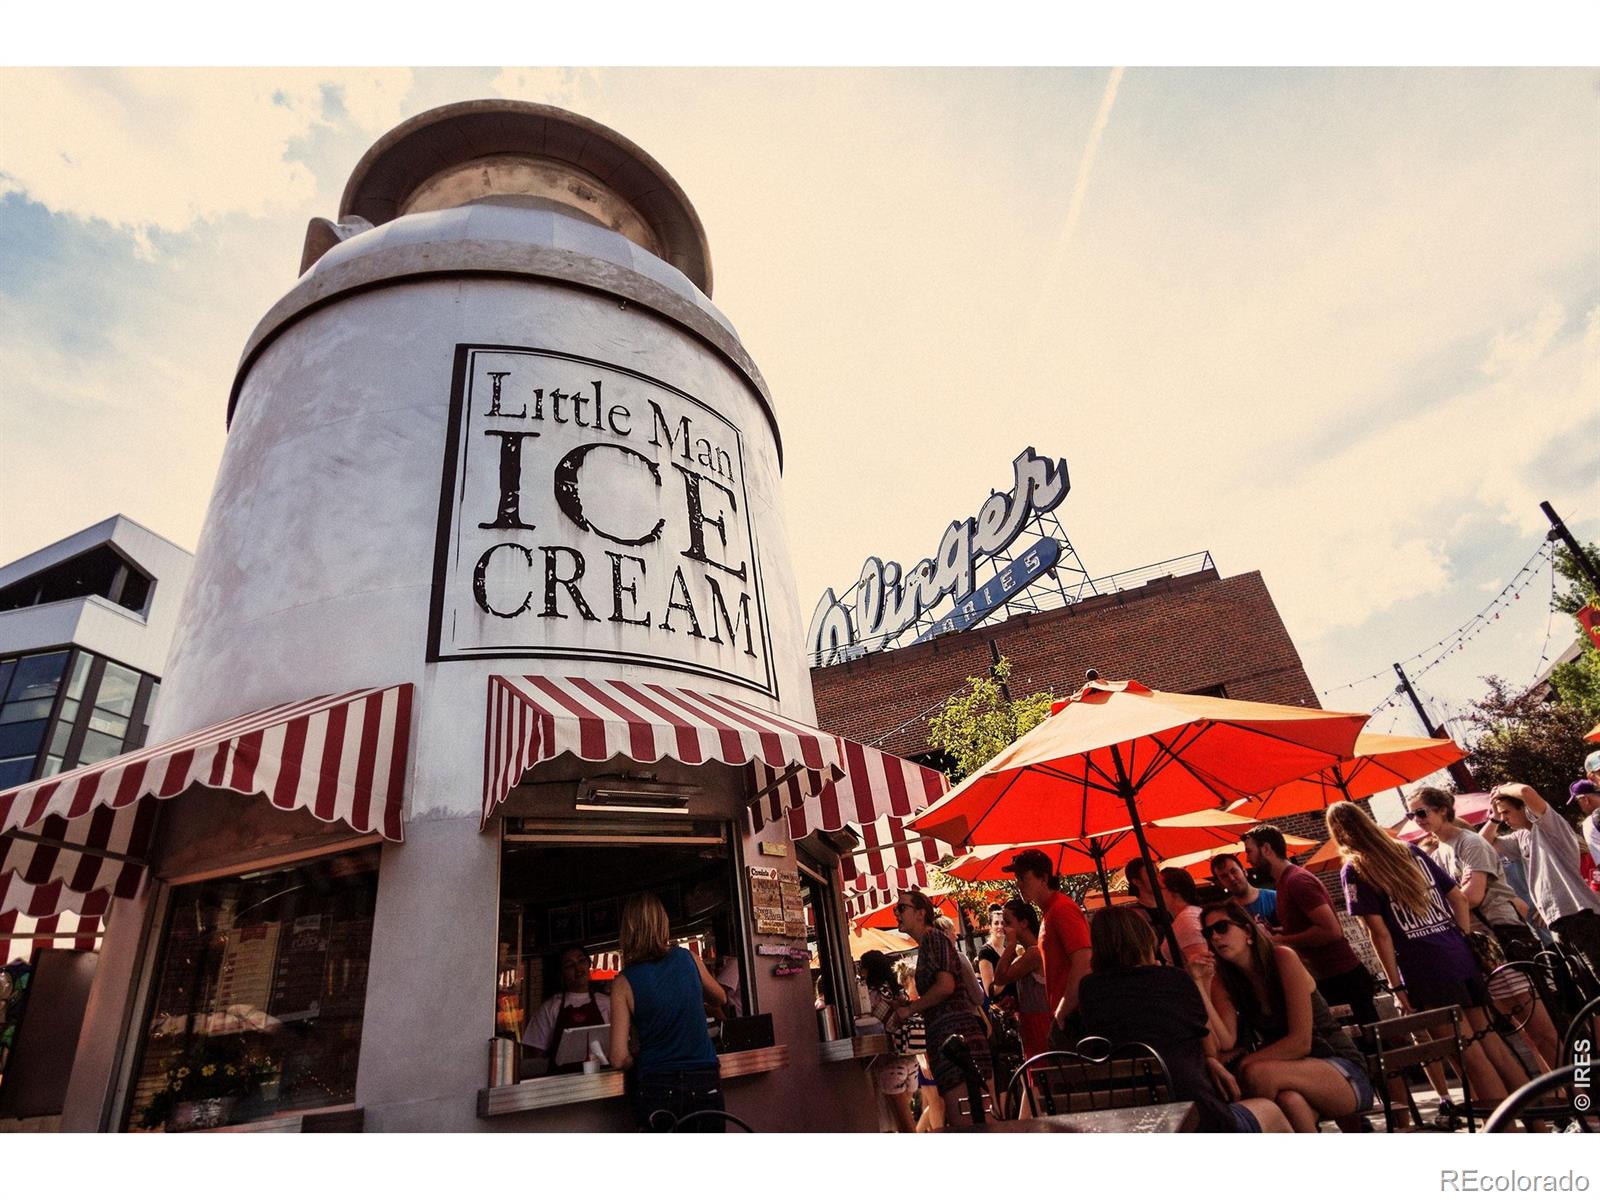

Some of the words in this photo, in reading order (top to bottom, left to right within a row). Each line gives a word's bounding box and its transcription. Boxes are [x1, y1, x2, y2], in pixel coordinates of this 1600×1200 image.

[648, 398, 736, 484] Man
[477, 429, 748, 583] ICE
[472, 542, 758, 659] CREAM
